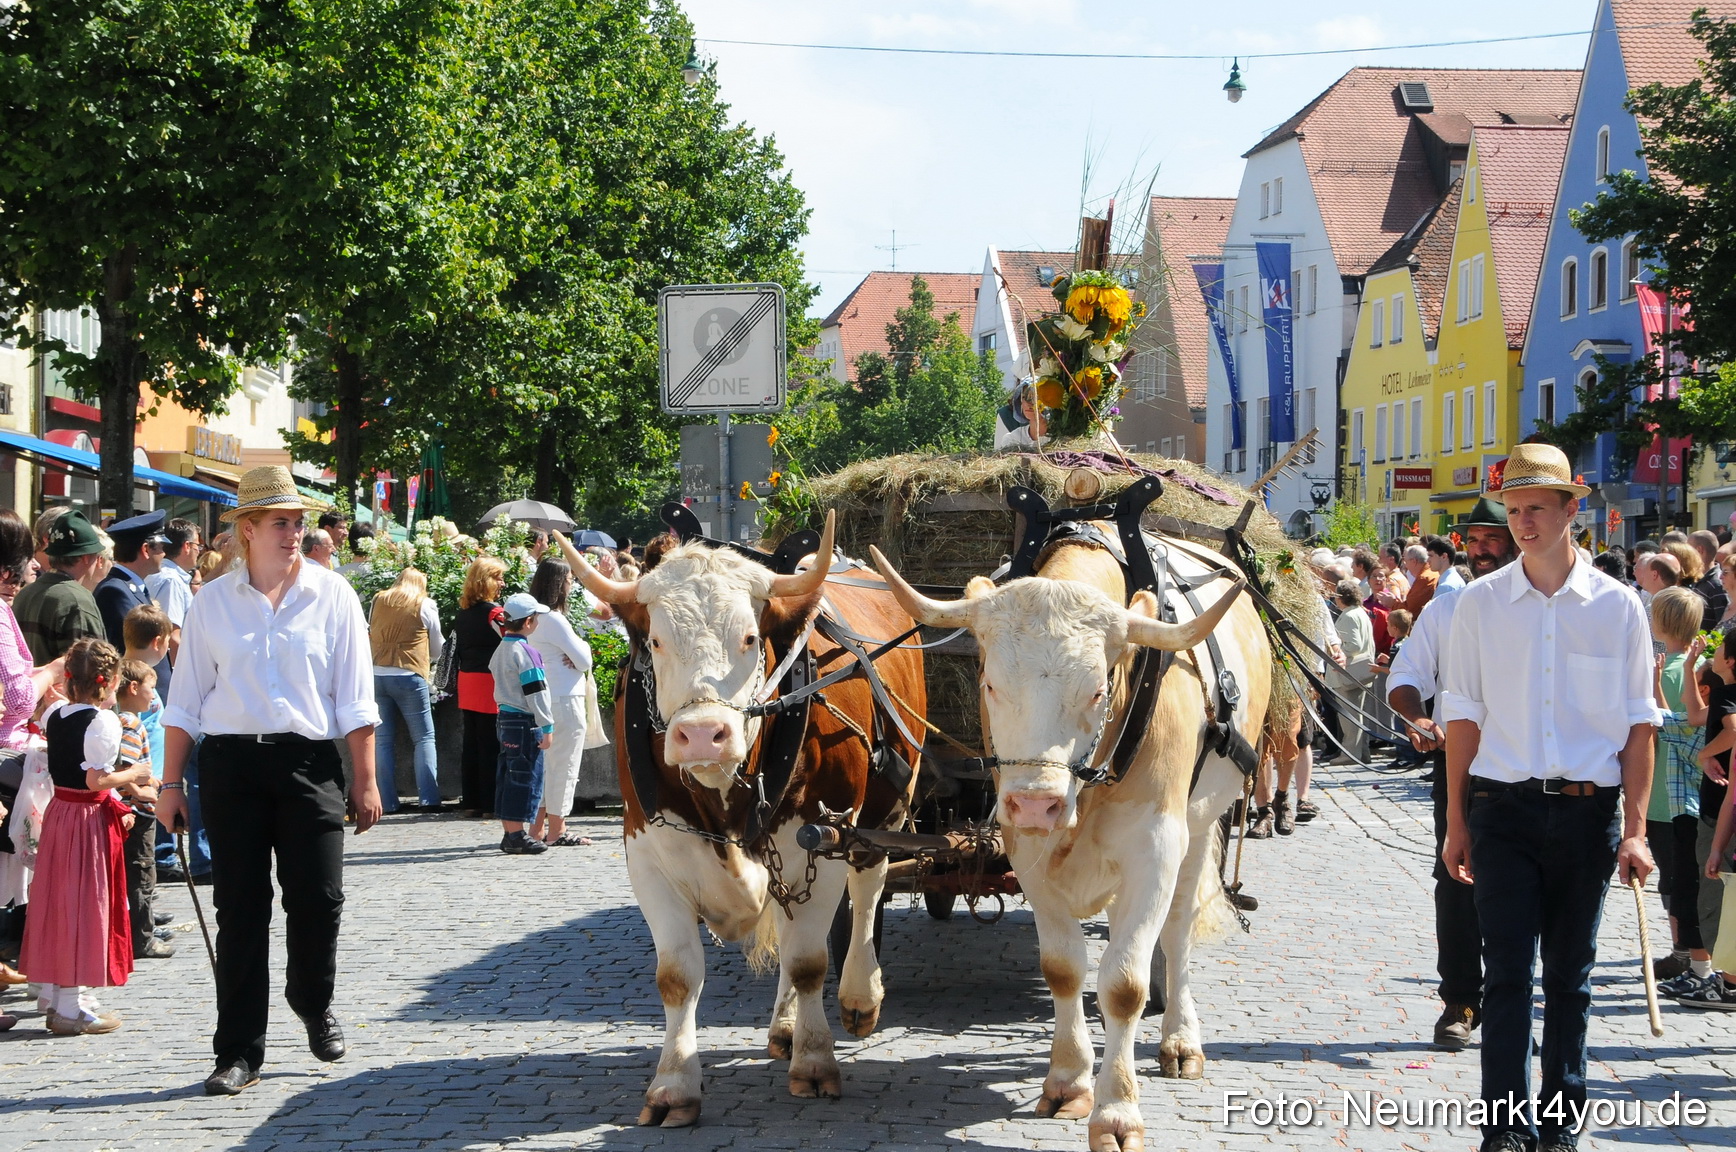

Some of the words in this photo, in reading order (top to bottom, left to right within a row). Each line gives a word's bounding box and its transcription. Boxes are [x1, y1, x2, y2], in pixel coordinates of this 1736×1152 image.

[695, 377, 750, 396] ZONE
[1381, 372, 1403, 396] HOTEL
[1396, 474, 1431, 483] WISSMACH
